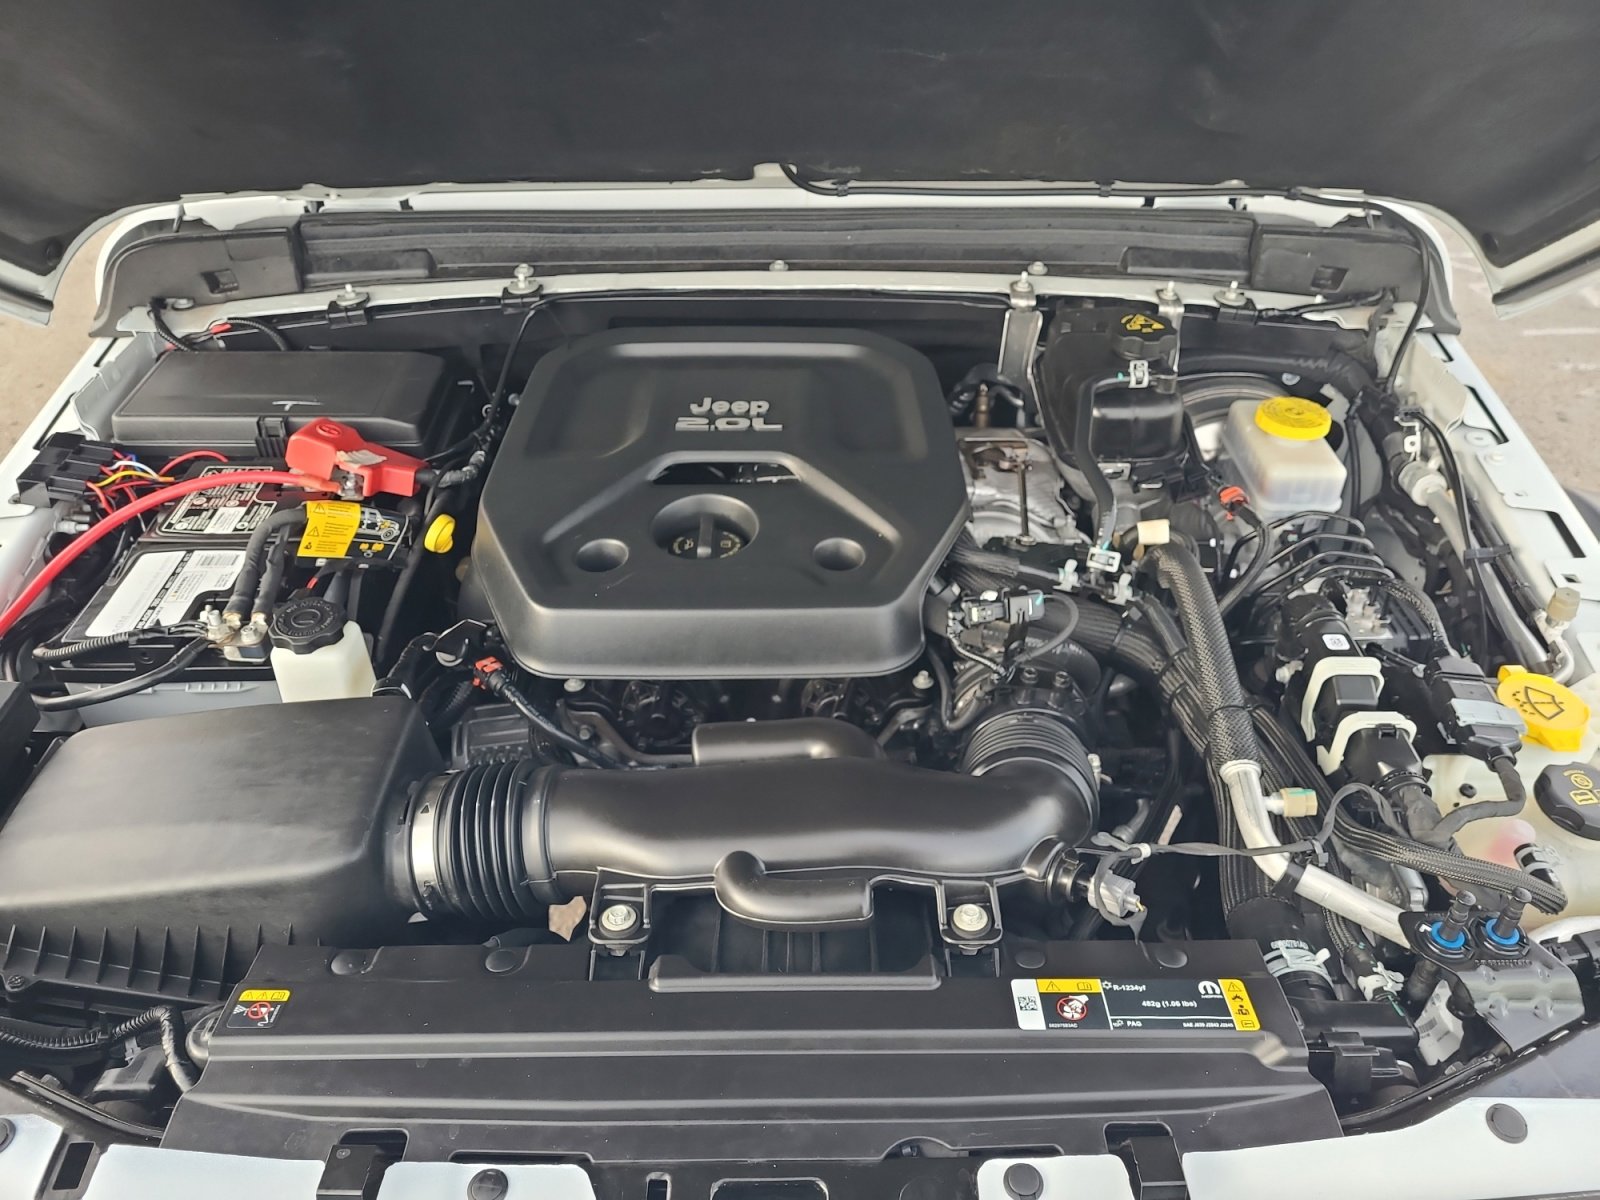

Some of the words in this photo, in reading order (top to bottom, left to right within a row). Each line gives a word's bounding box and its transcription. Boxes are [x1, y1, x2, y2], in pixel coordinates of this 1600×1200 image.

[689, 396, 770, 417] Jeep
[675, 416, 783, 432] 2.0L
[1112, 984, 1146, 993] R-1234yf
[1182, 1000, 1198, 1008] lbs)
[1126, 1020, 1143, 1028] PAG
